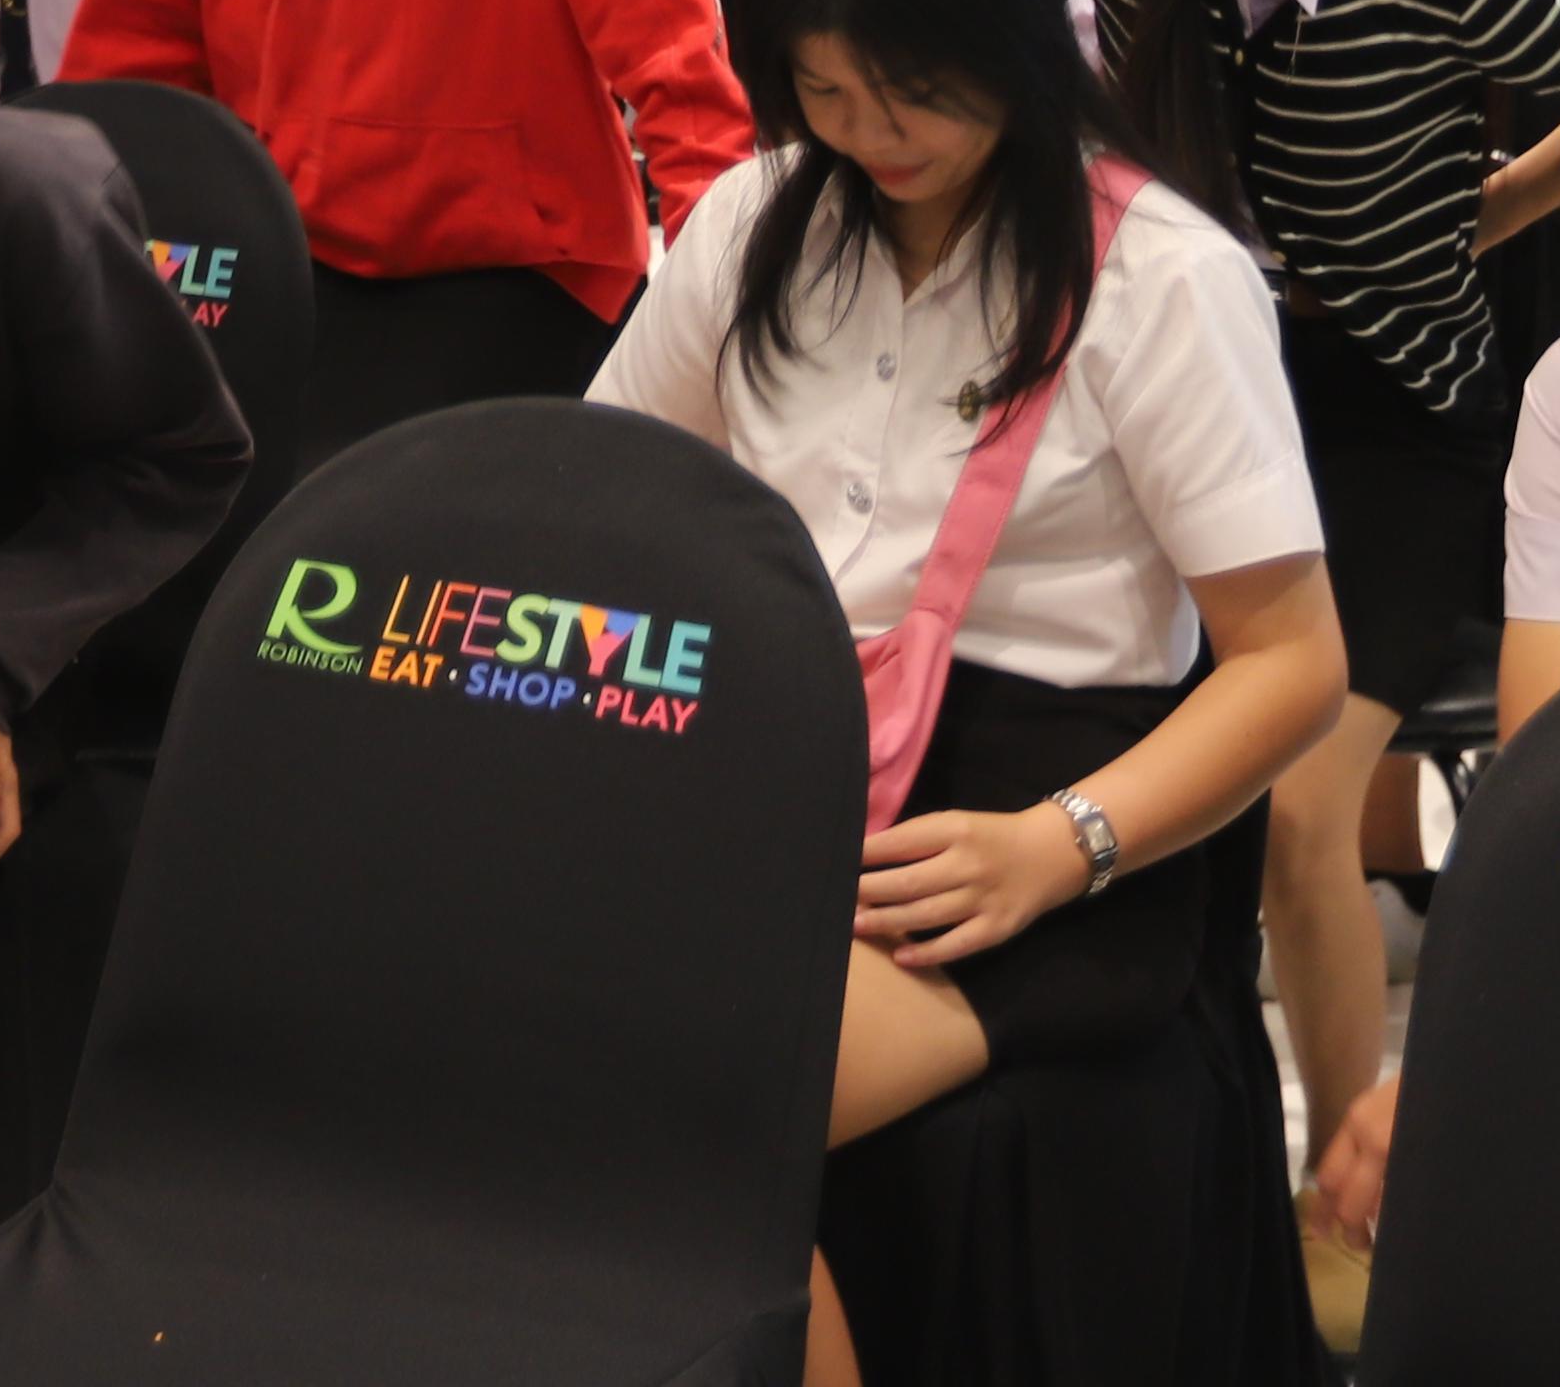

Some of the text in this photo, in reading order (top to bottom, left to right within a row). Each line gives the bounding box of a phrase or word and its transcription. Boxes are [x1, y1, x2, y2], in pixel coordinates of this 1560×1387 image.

[192, 300, 230, 328] AY
[264, 557, 712, 694] R LIFESTYLE
[256, 639, 698, 735] ROBINSON EAT SHOP PLAY
